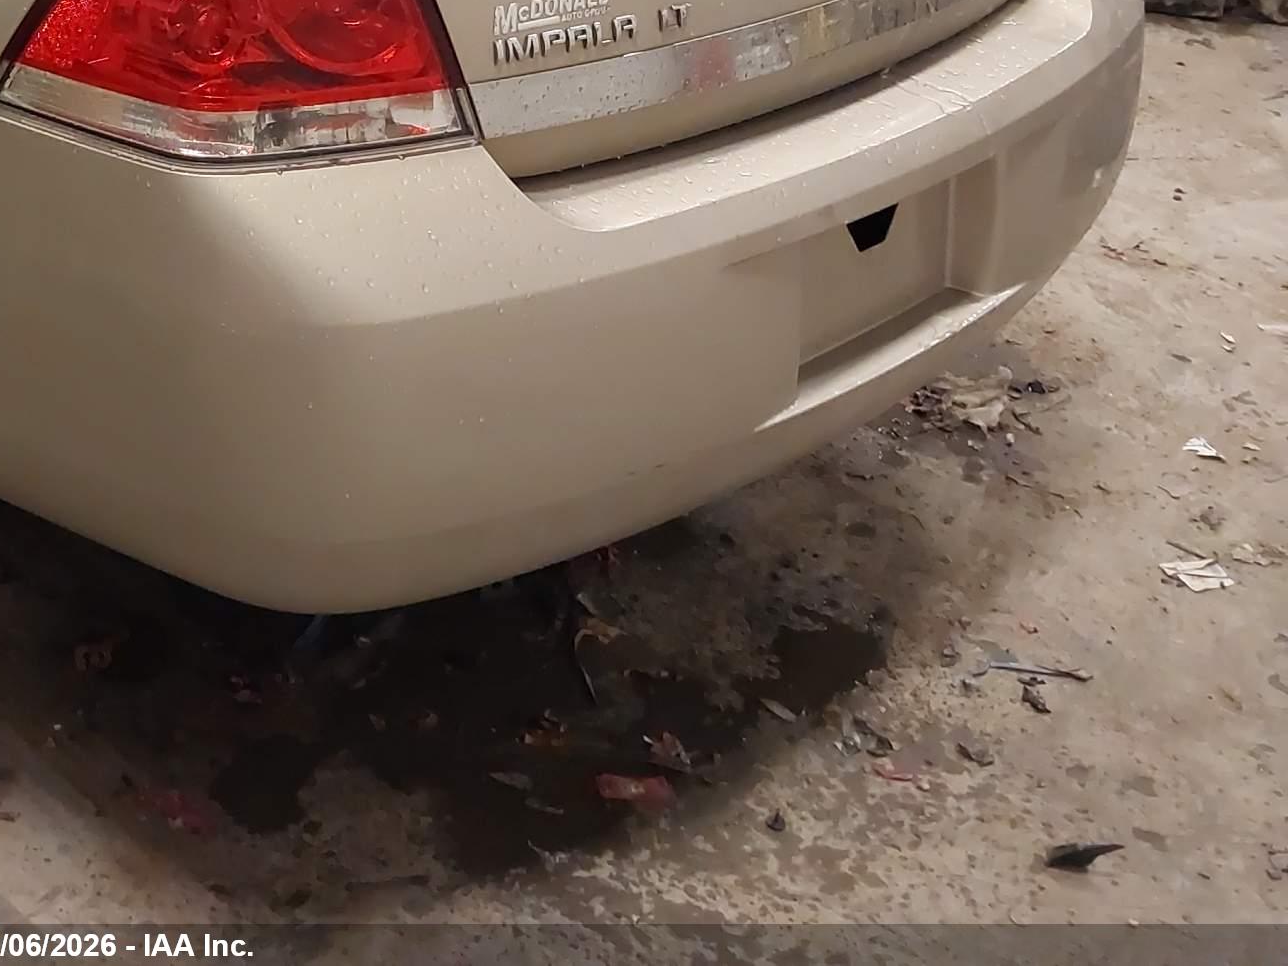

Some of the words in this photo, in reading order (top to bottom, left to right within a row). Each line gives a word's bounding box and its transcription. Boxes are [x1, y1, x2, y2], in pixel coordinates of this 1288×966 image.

[494, 14, 638, 65] IMPALA
[658, 2, 693, 32] LT
[561, 10, 583, 22] AUTO
